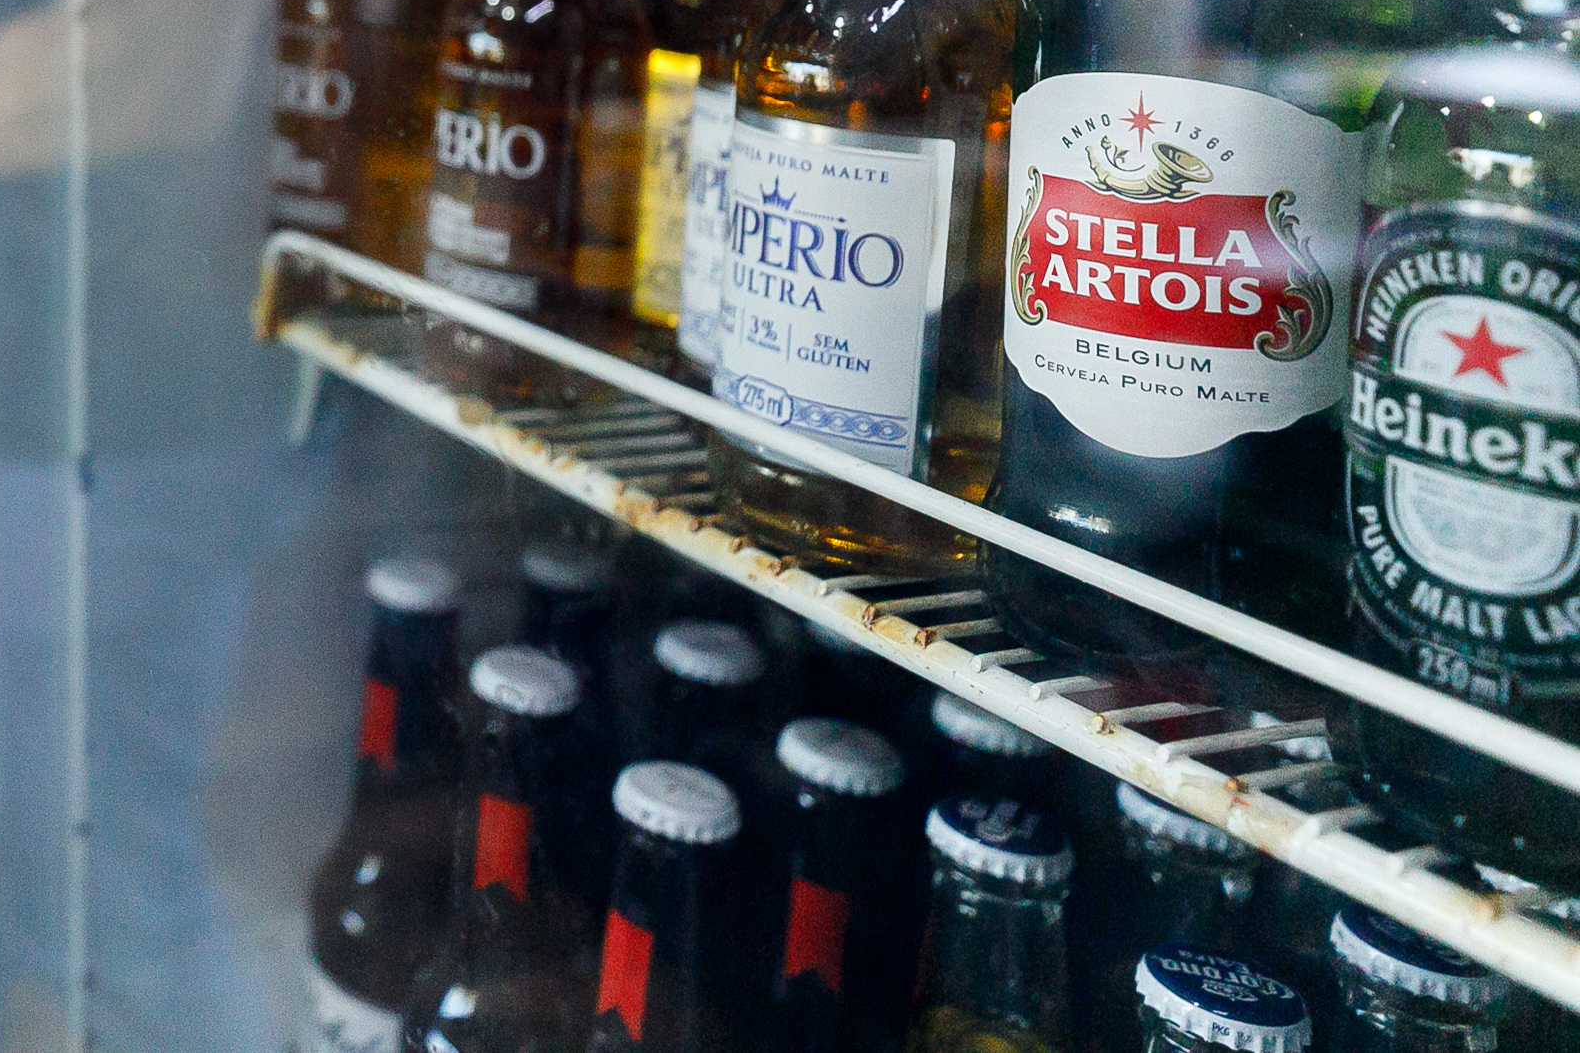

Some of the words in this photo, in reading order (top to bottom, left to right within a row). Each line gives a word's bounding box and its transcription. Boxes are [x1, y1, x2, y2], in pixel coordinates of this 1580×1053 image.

[1061, 113, 1110, 149] ANNO
[1174, 120, 1234, 162] 1366
[769, 153, 812, 172] PURO
[822, 163, 890, 184] MALTE
[1045, 208, 1262, 268] STELLA
[733, 261, 824, 313] ULTRA
[1041, 252, 1262, 315] ARTOIS
[1367, 250, 1484, 342] HEINEKEN
[749, 315, 778, 342] 3%
[814, 332, 850, 353] SEM
[1076, 339, 1211, 373] BELGIUM
[1351, 371, 1580, 488] Heinek
[1357, 505, 1407, 589] PURE
[1411, 581, 1507, 639] MALT
[1212, 1020, 1231, 1037] PKG
